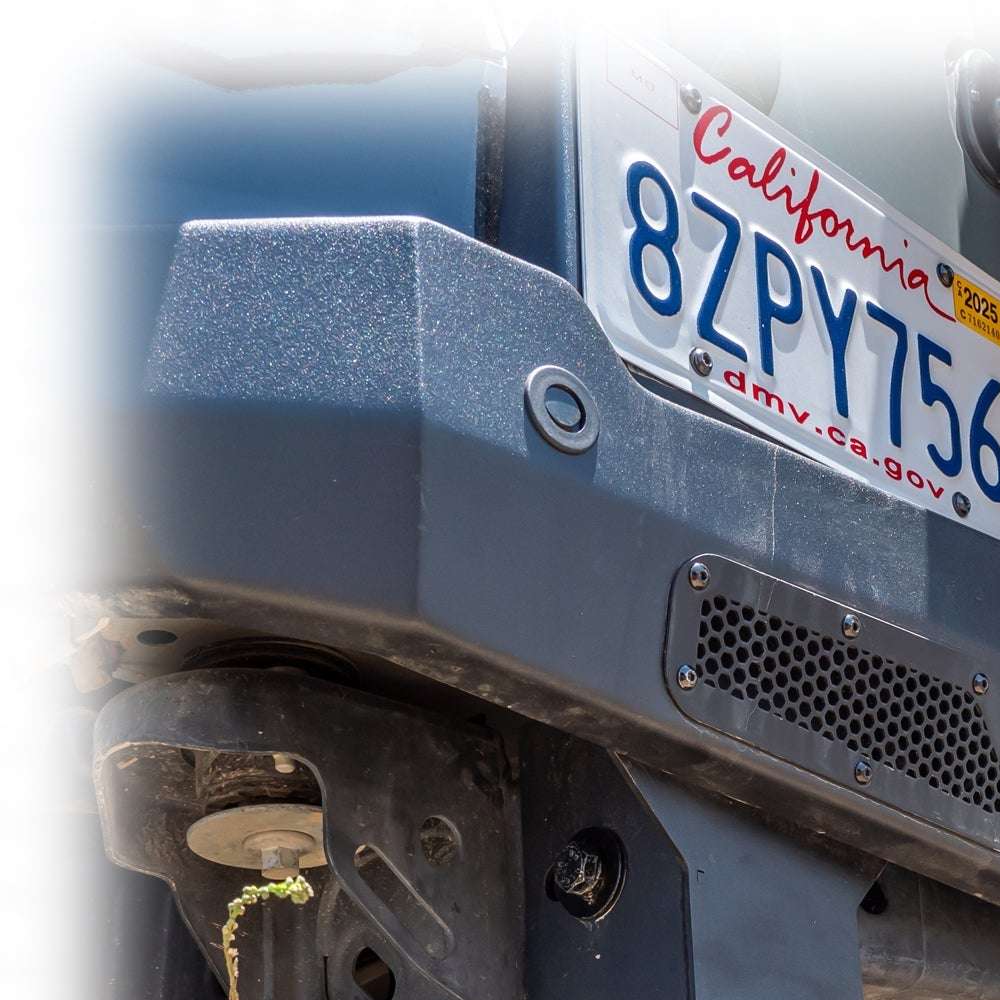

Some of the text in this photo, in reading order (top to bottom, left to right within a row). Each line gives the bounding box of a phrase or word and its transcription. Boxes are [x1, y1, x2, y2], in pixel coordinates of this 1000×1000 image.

[693, 104, 956, 323] California
[963, 287, 999, 324] 2025
[723, 369, 945, 499] dmv.ca.gov
